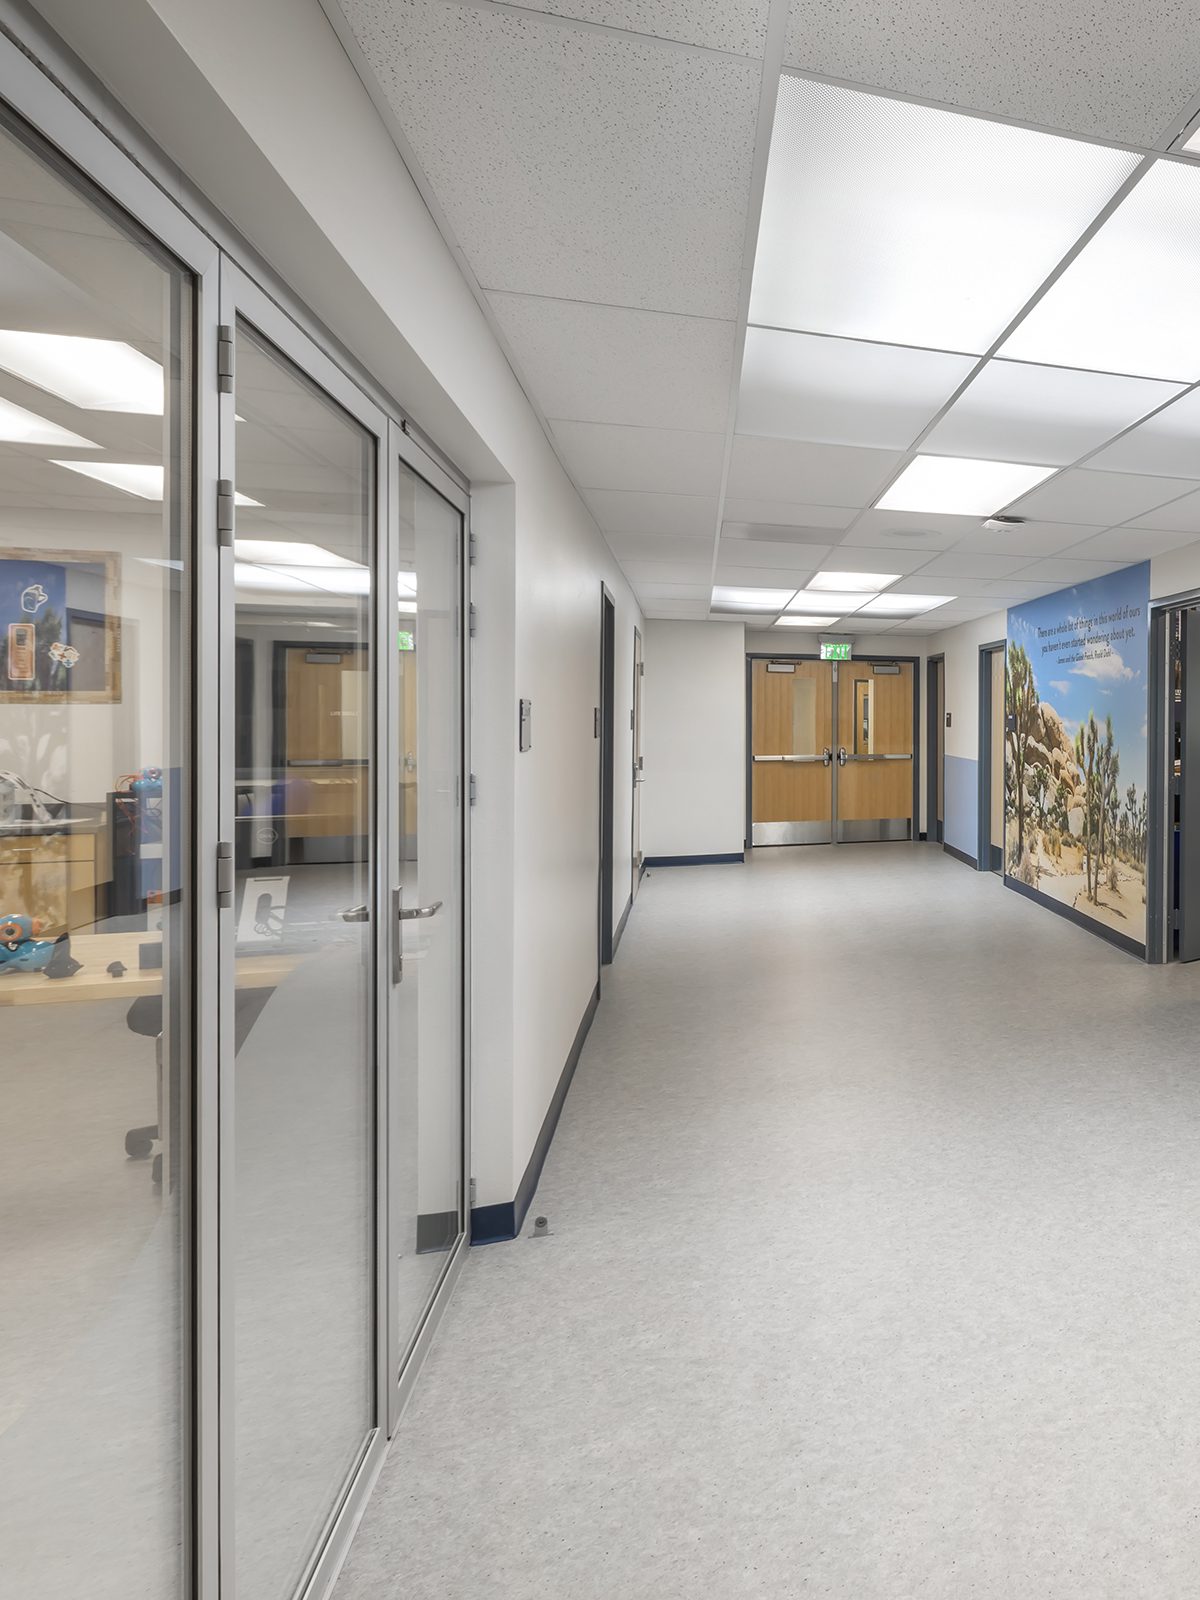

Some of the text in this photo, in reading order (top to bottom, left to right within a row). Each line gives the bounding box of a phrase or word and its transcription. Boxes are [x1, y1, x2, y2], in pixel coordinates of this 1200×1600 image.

[1057, 621, 1067, 633] whole
[1079, 616, 1092, 632] things
[1099, 611, 1107, 624] this
[1108, 607, 1122, 622] world
[1122, 605, 1129, 619] of
[1129, 608, 1140, 618] ours
[1071, 633, 1086, 648] started
[1086, 630, 1110, 646] wondering
[1110, 627, 1124, 640] about
[825, 644, 848, 660] EXIT
